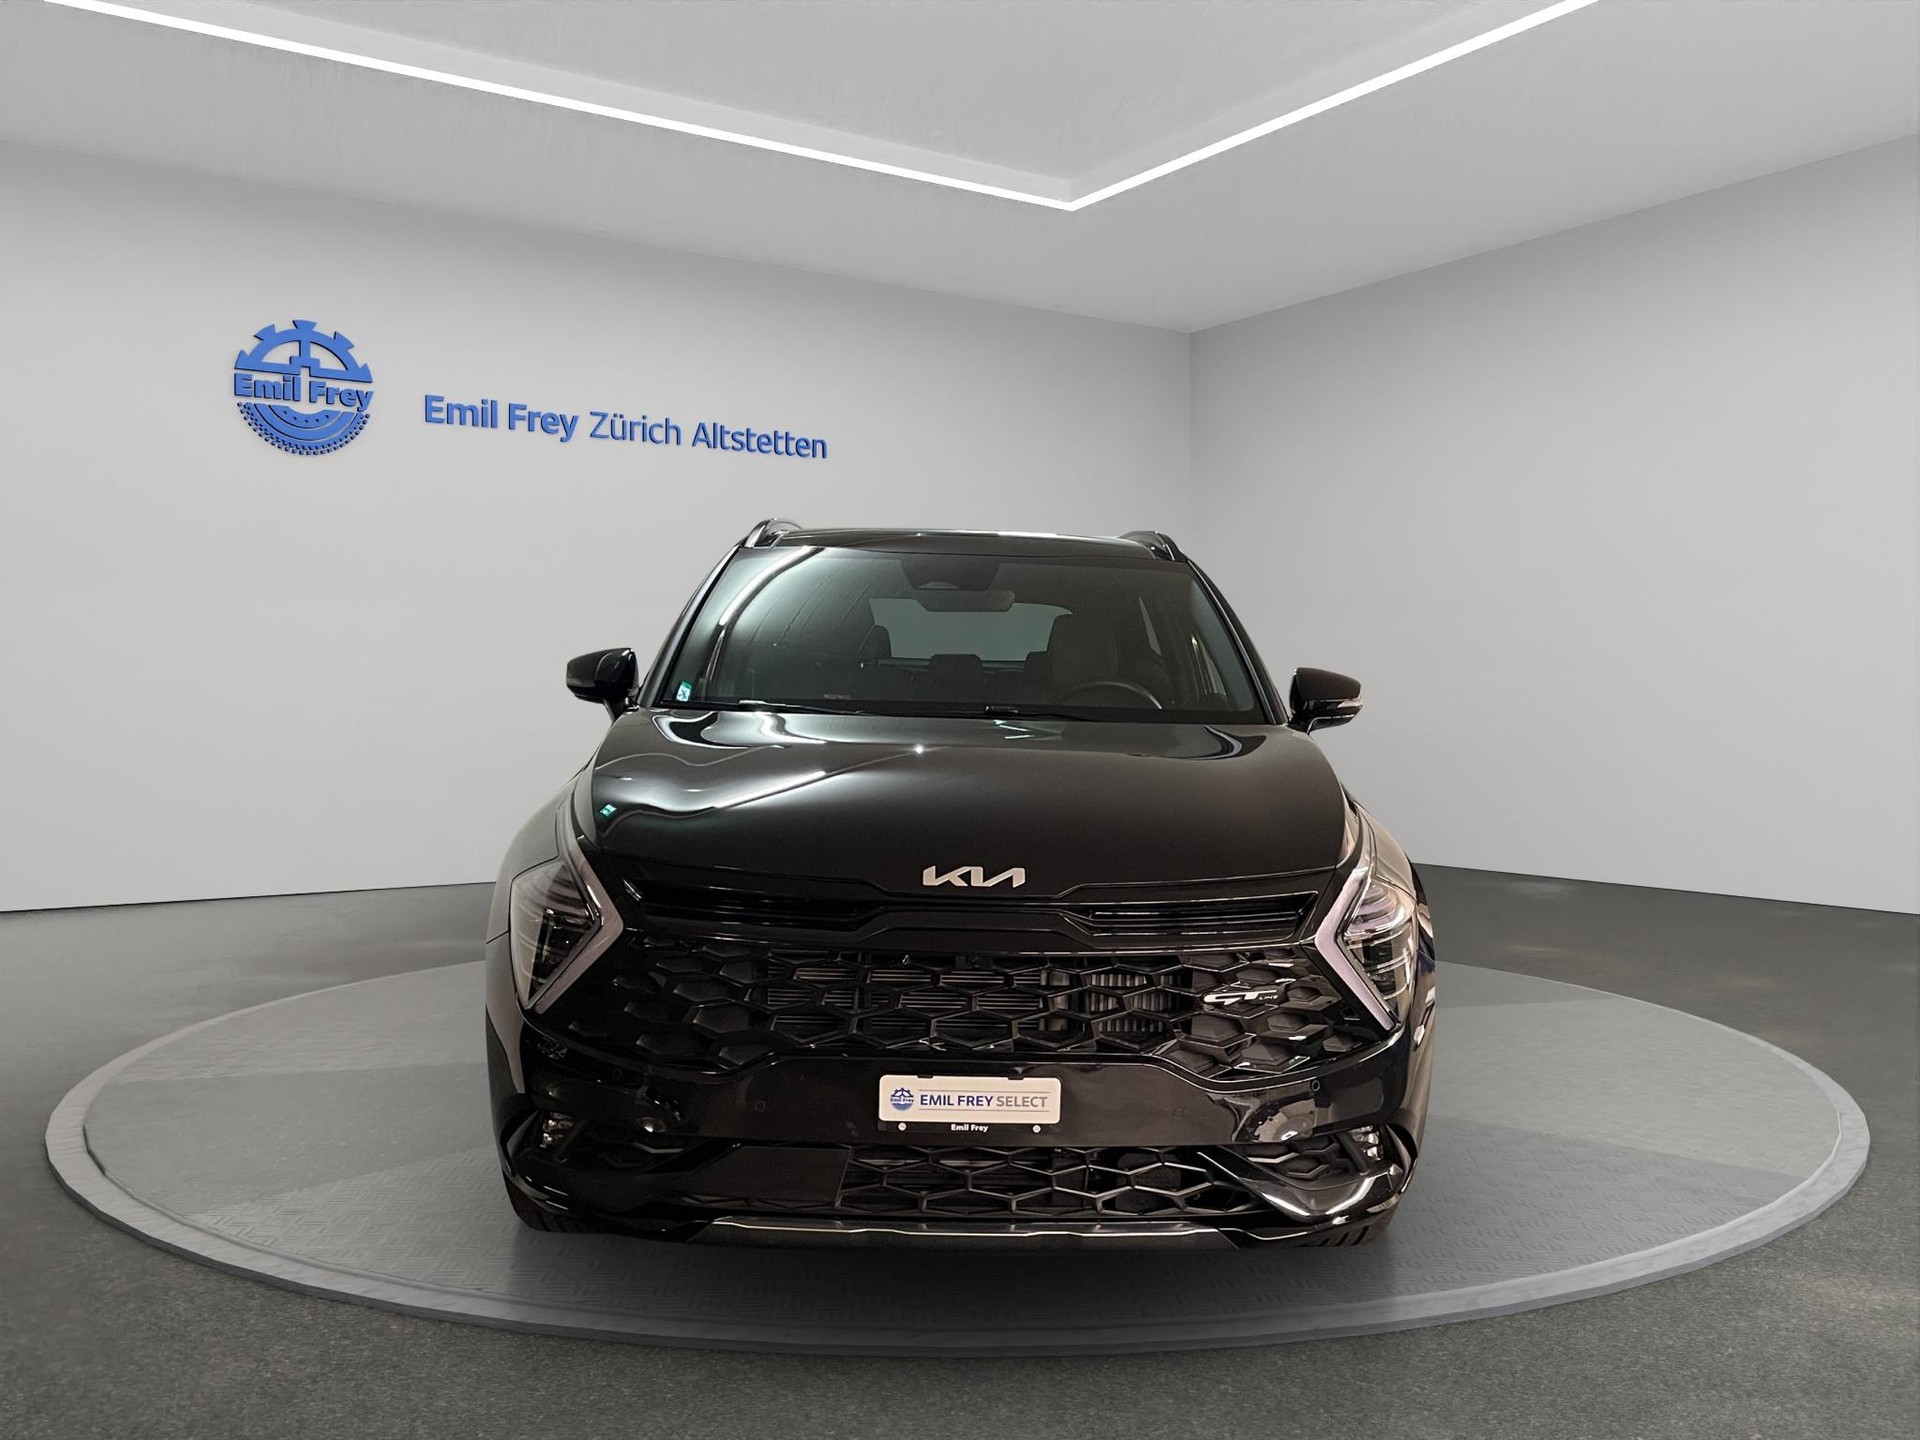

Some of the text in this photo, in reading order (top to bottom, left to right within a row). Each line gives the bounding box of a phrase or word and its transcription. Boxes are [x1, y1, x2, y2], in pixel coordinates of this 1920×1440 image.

[233, 373, 374, 412] Emil Frey
[424, 394, 828, 459] Emil Frey Zürich Altstetten
[922, 865, 1026, 888] KIA
[920, 1094, 954, 1106] EMIL
[957, 1095, 994, 1107] FREY
[996, 1095, 1048, 1108] SELECT
[950, 1123, 989, 1133] Emil Frey
